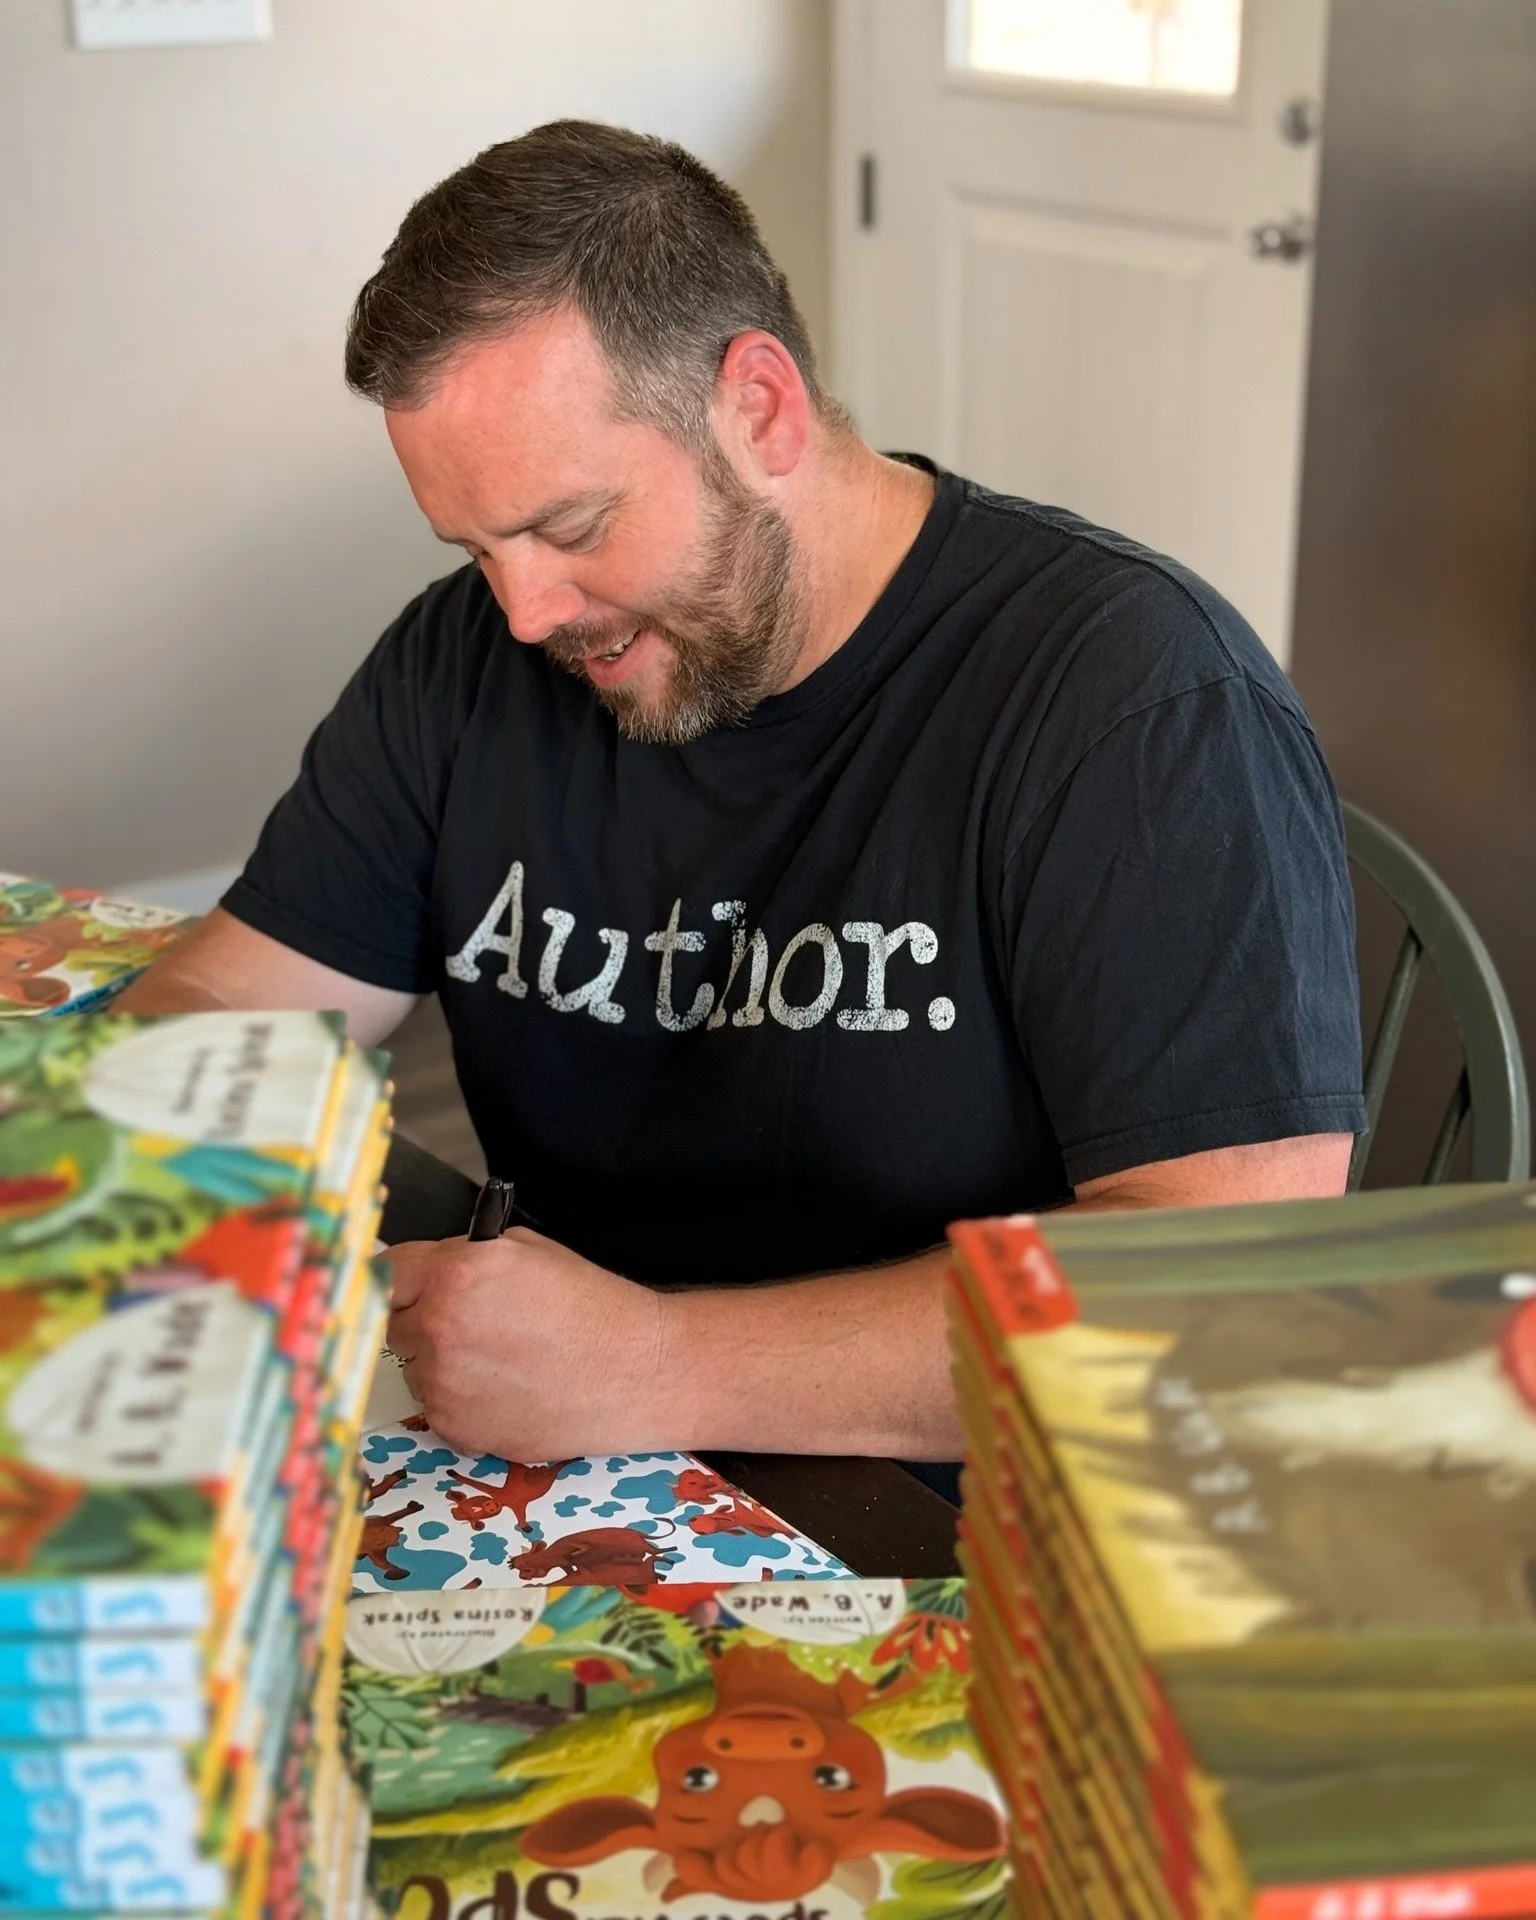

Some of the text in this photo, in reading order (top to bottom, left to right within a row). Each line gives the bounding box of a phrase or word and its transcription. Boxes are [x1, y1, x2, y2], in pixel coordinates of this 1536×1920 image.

[445, 860, 957, 1033] Author.
[731, 1595, 810, 1612] Wade
[362, 1607, 534, 1627] Rosina Spivak
